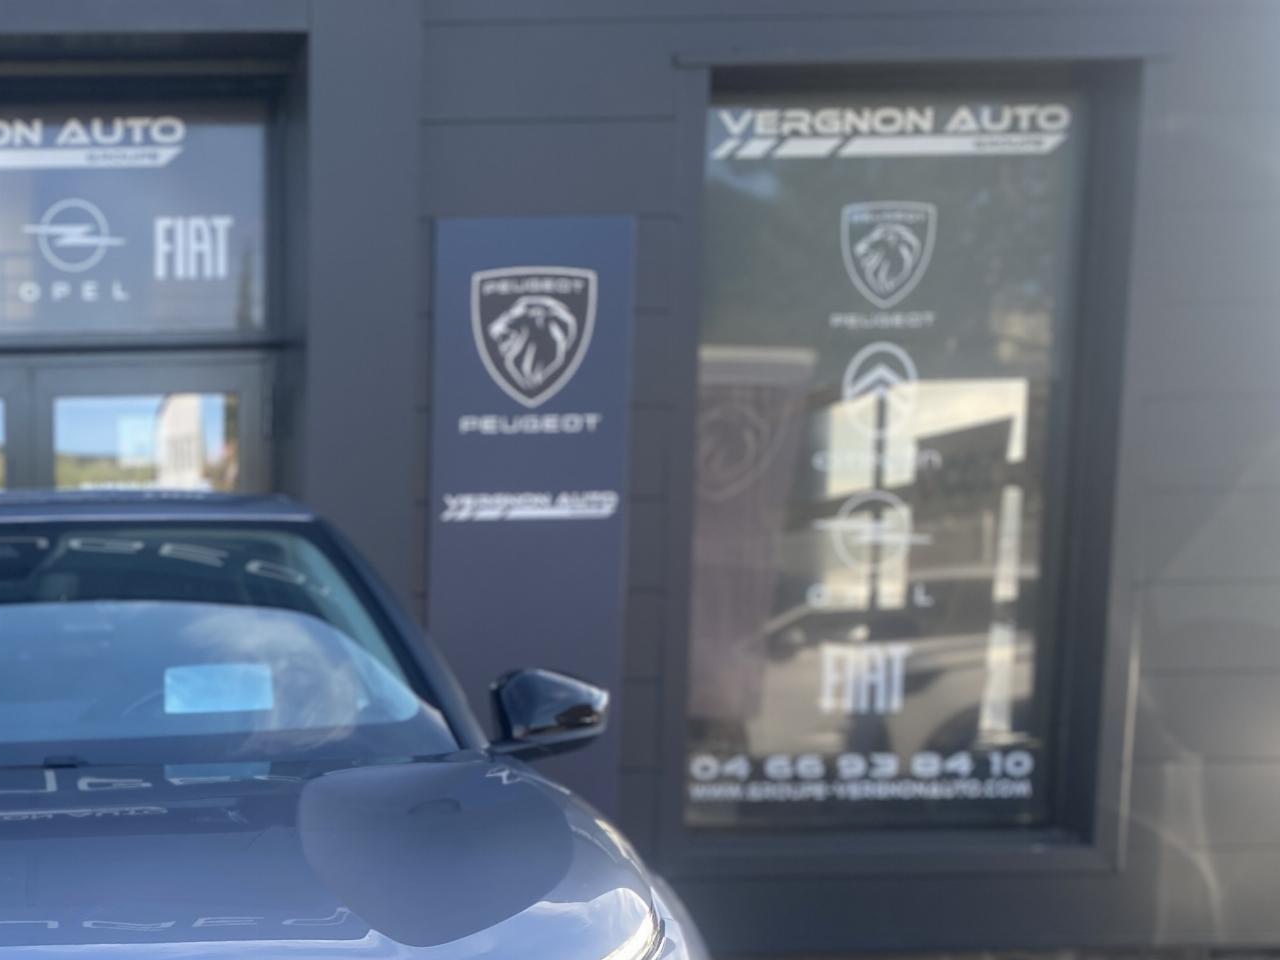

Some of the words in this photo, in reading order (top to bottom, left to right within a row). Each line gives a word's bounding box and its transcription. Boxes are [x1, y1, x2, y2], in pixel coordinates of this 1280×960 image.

[54, 116, 186, 145] AUTO
[718, 106, 935, 135] VERGNON
[944, 103, 1071, 132] AUTO
[153, 215, 234, 280] FIAT
[18, 280, 130, 301] OPEL
[458, 412, 603, 434] PEUGEOT
[820, 641, 913, 714] FIAT
[690, 754, 751, 782] 04
[988, 750, 1034, 778] 10
